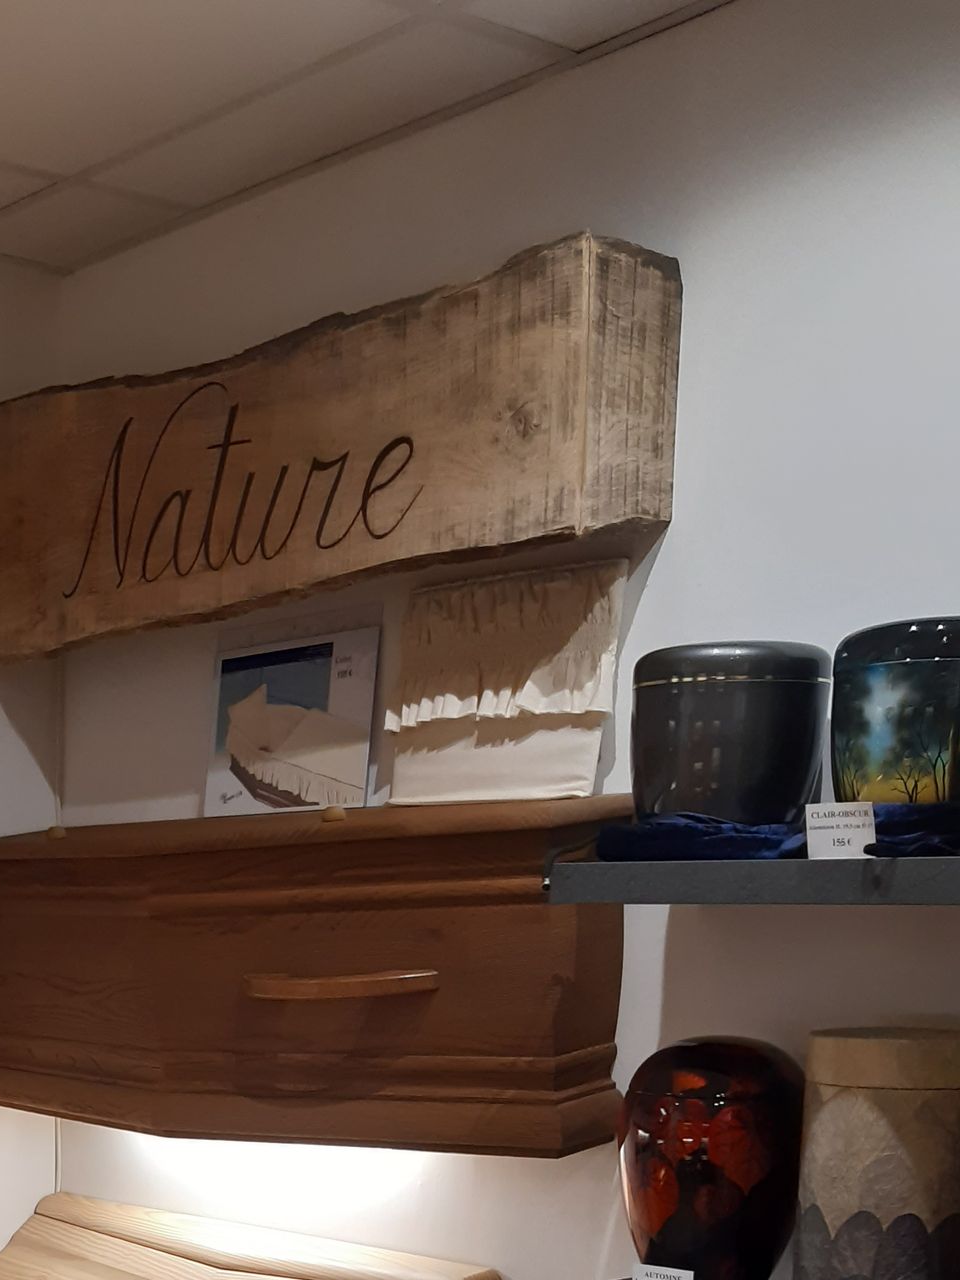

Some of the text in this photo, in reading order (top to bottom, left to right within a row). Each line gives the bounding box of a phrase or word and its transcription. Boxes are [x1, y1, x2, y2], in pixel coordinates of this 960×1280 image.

[62, 380, 424, 599] Nature
[811, 810, 869, 819] CLAIR-OBSCUR
[833, 838, 846, 847] 155
